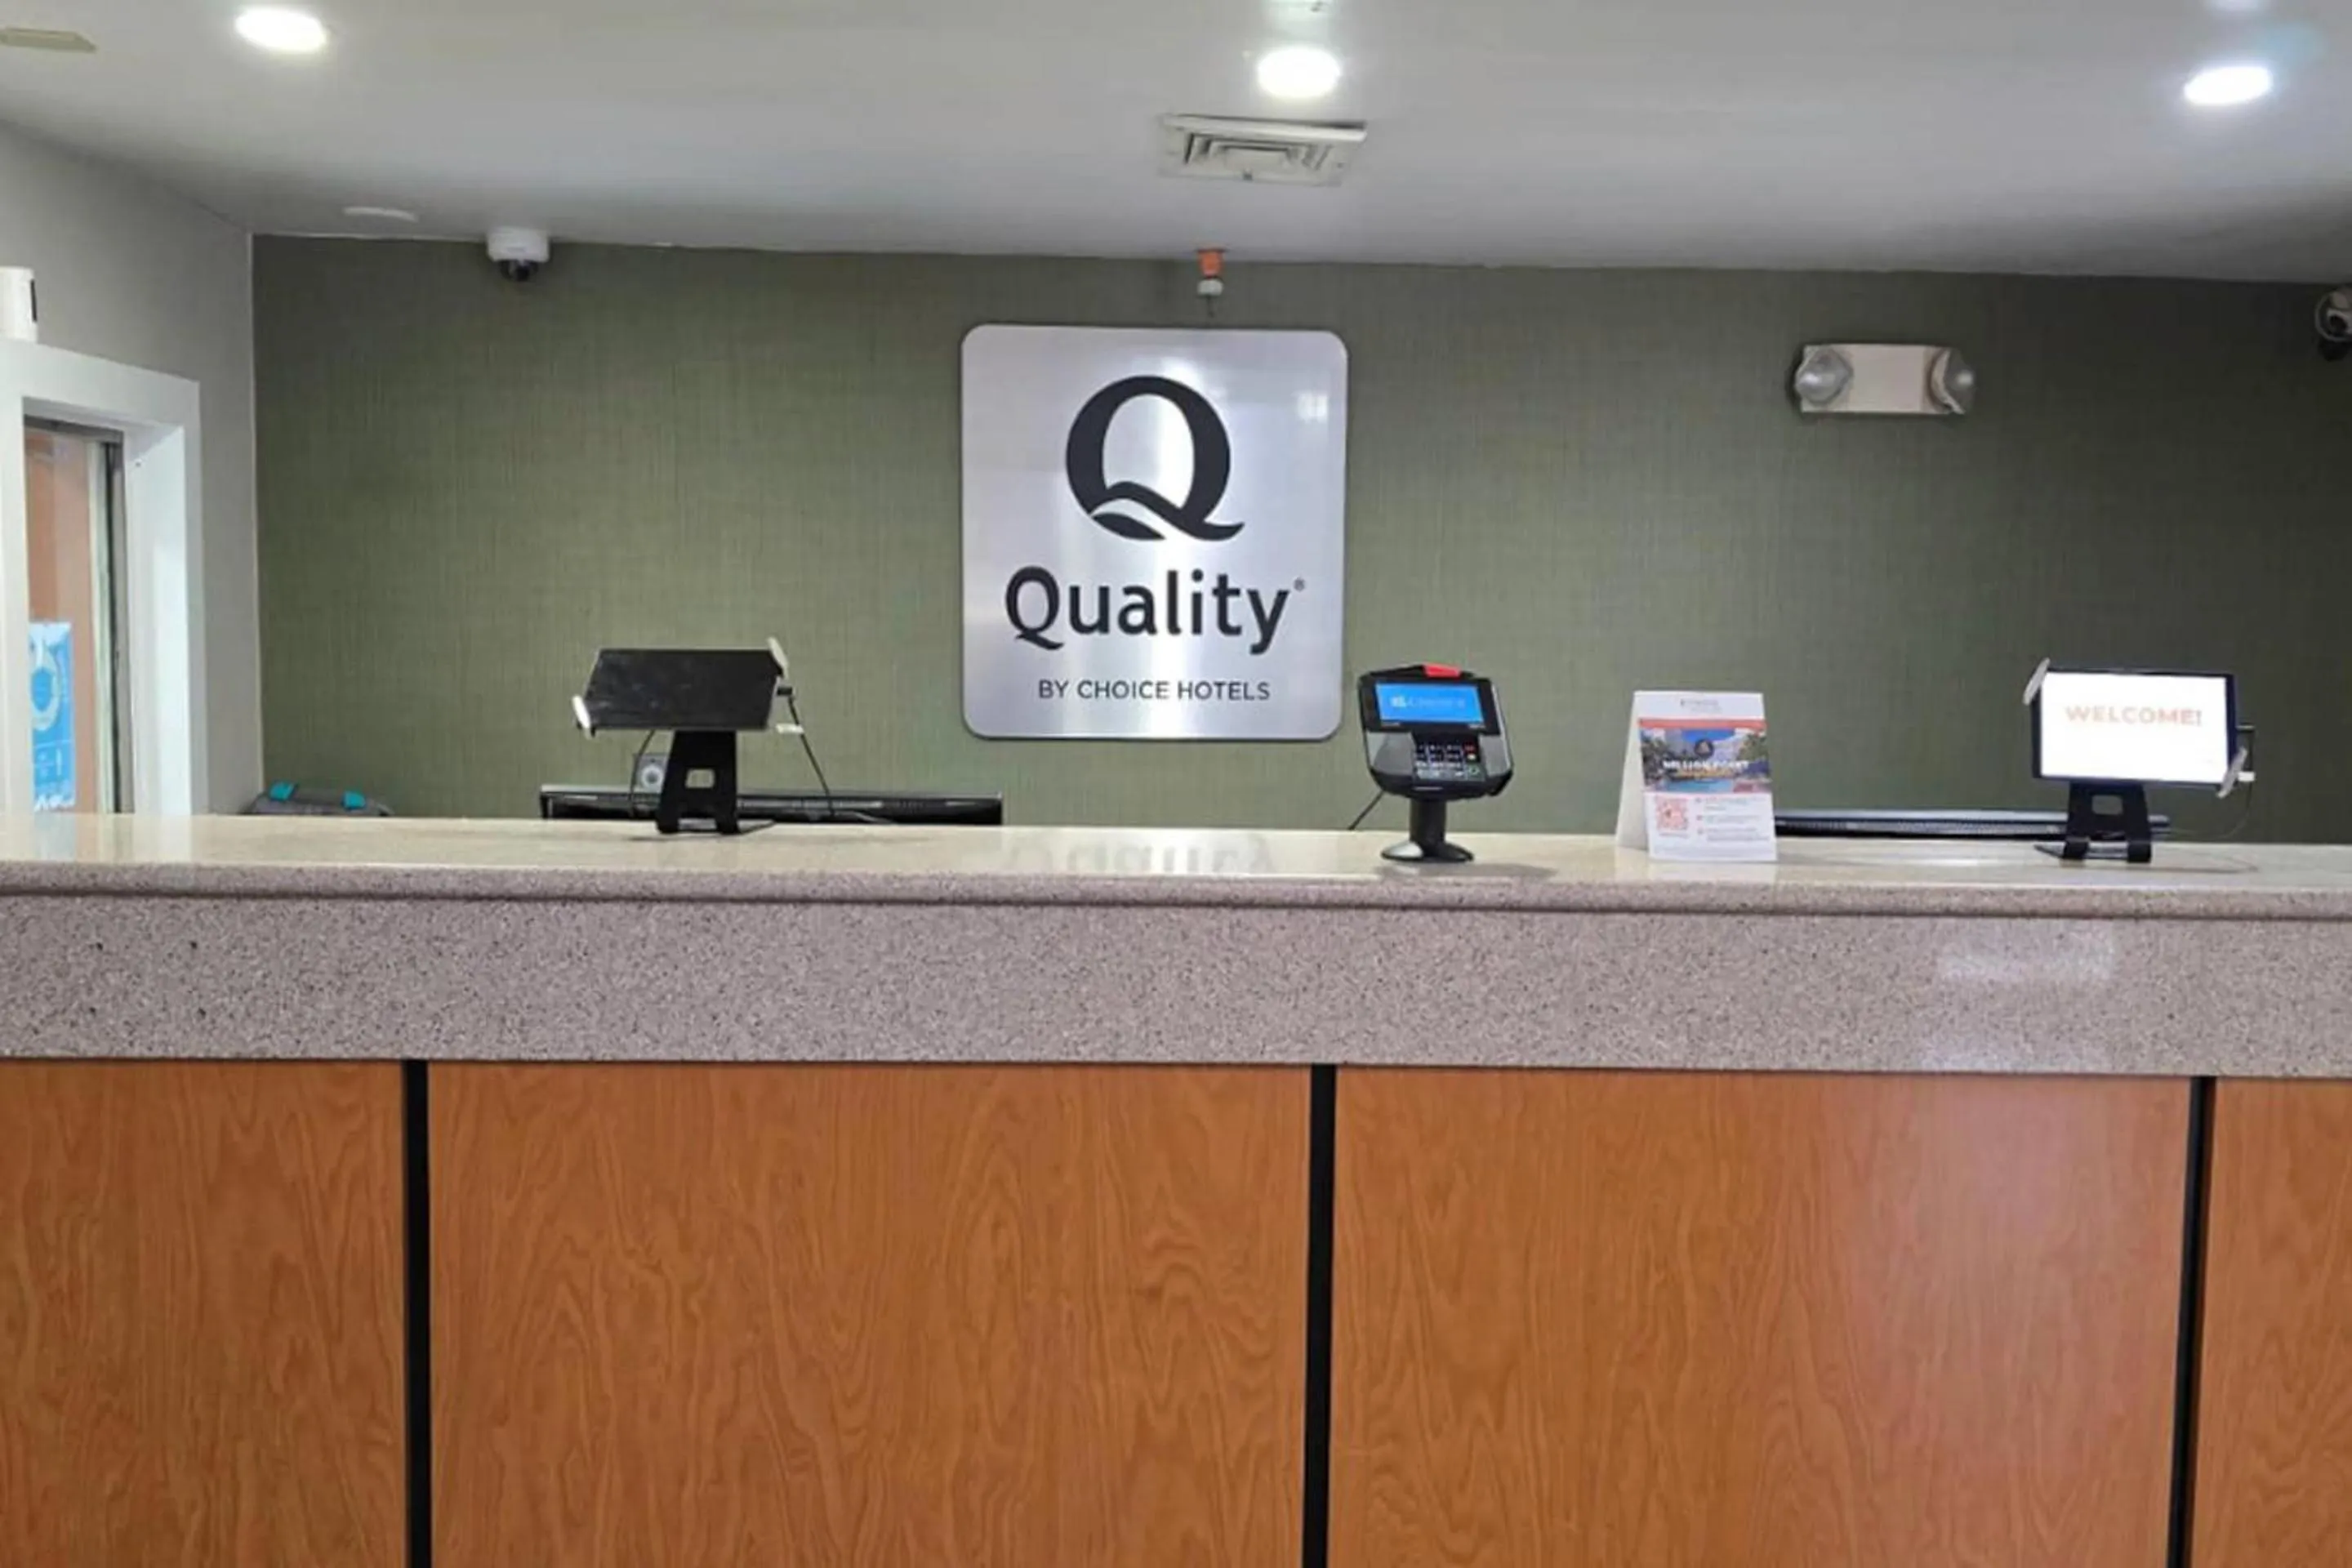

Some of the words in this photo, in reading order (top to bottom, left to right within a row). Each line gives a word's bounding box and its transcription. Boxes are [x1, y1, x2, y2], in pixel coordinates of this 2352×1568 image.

[1038, 679, 1069, 700] BY
[1076, 679, 1169, 700] CHOICE
[1178, 680, 1271, 702] HOTELS
[2065, 705, 2203, 727] WELCOME!
